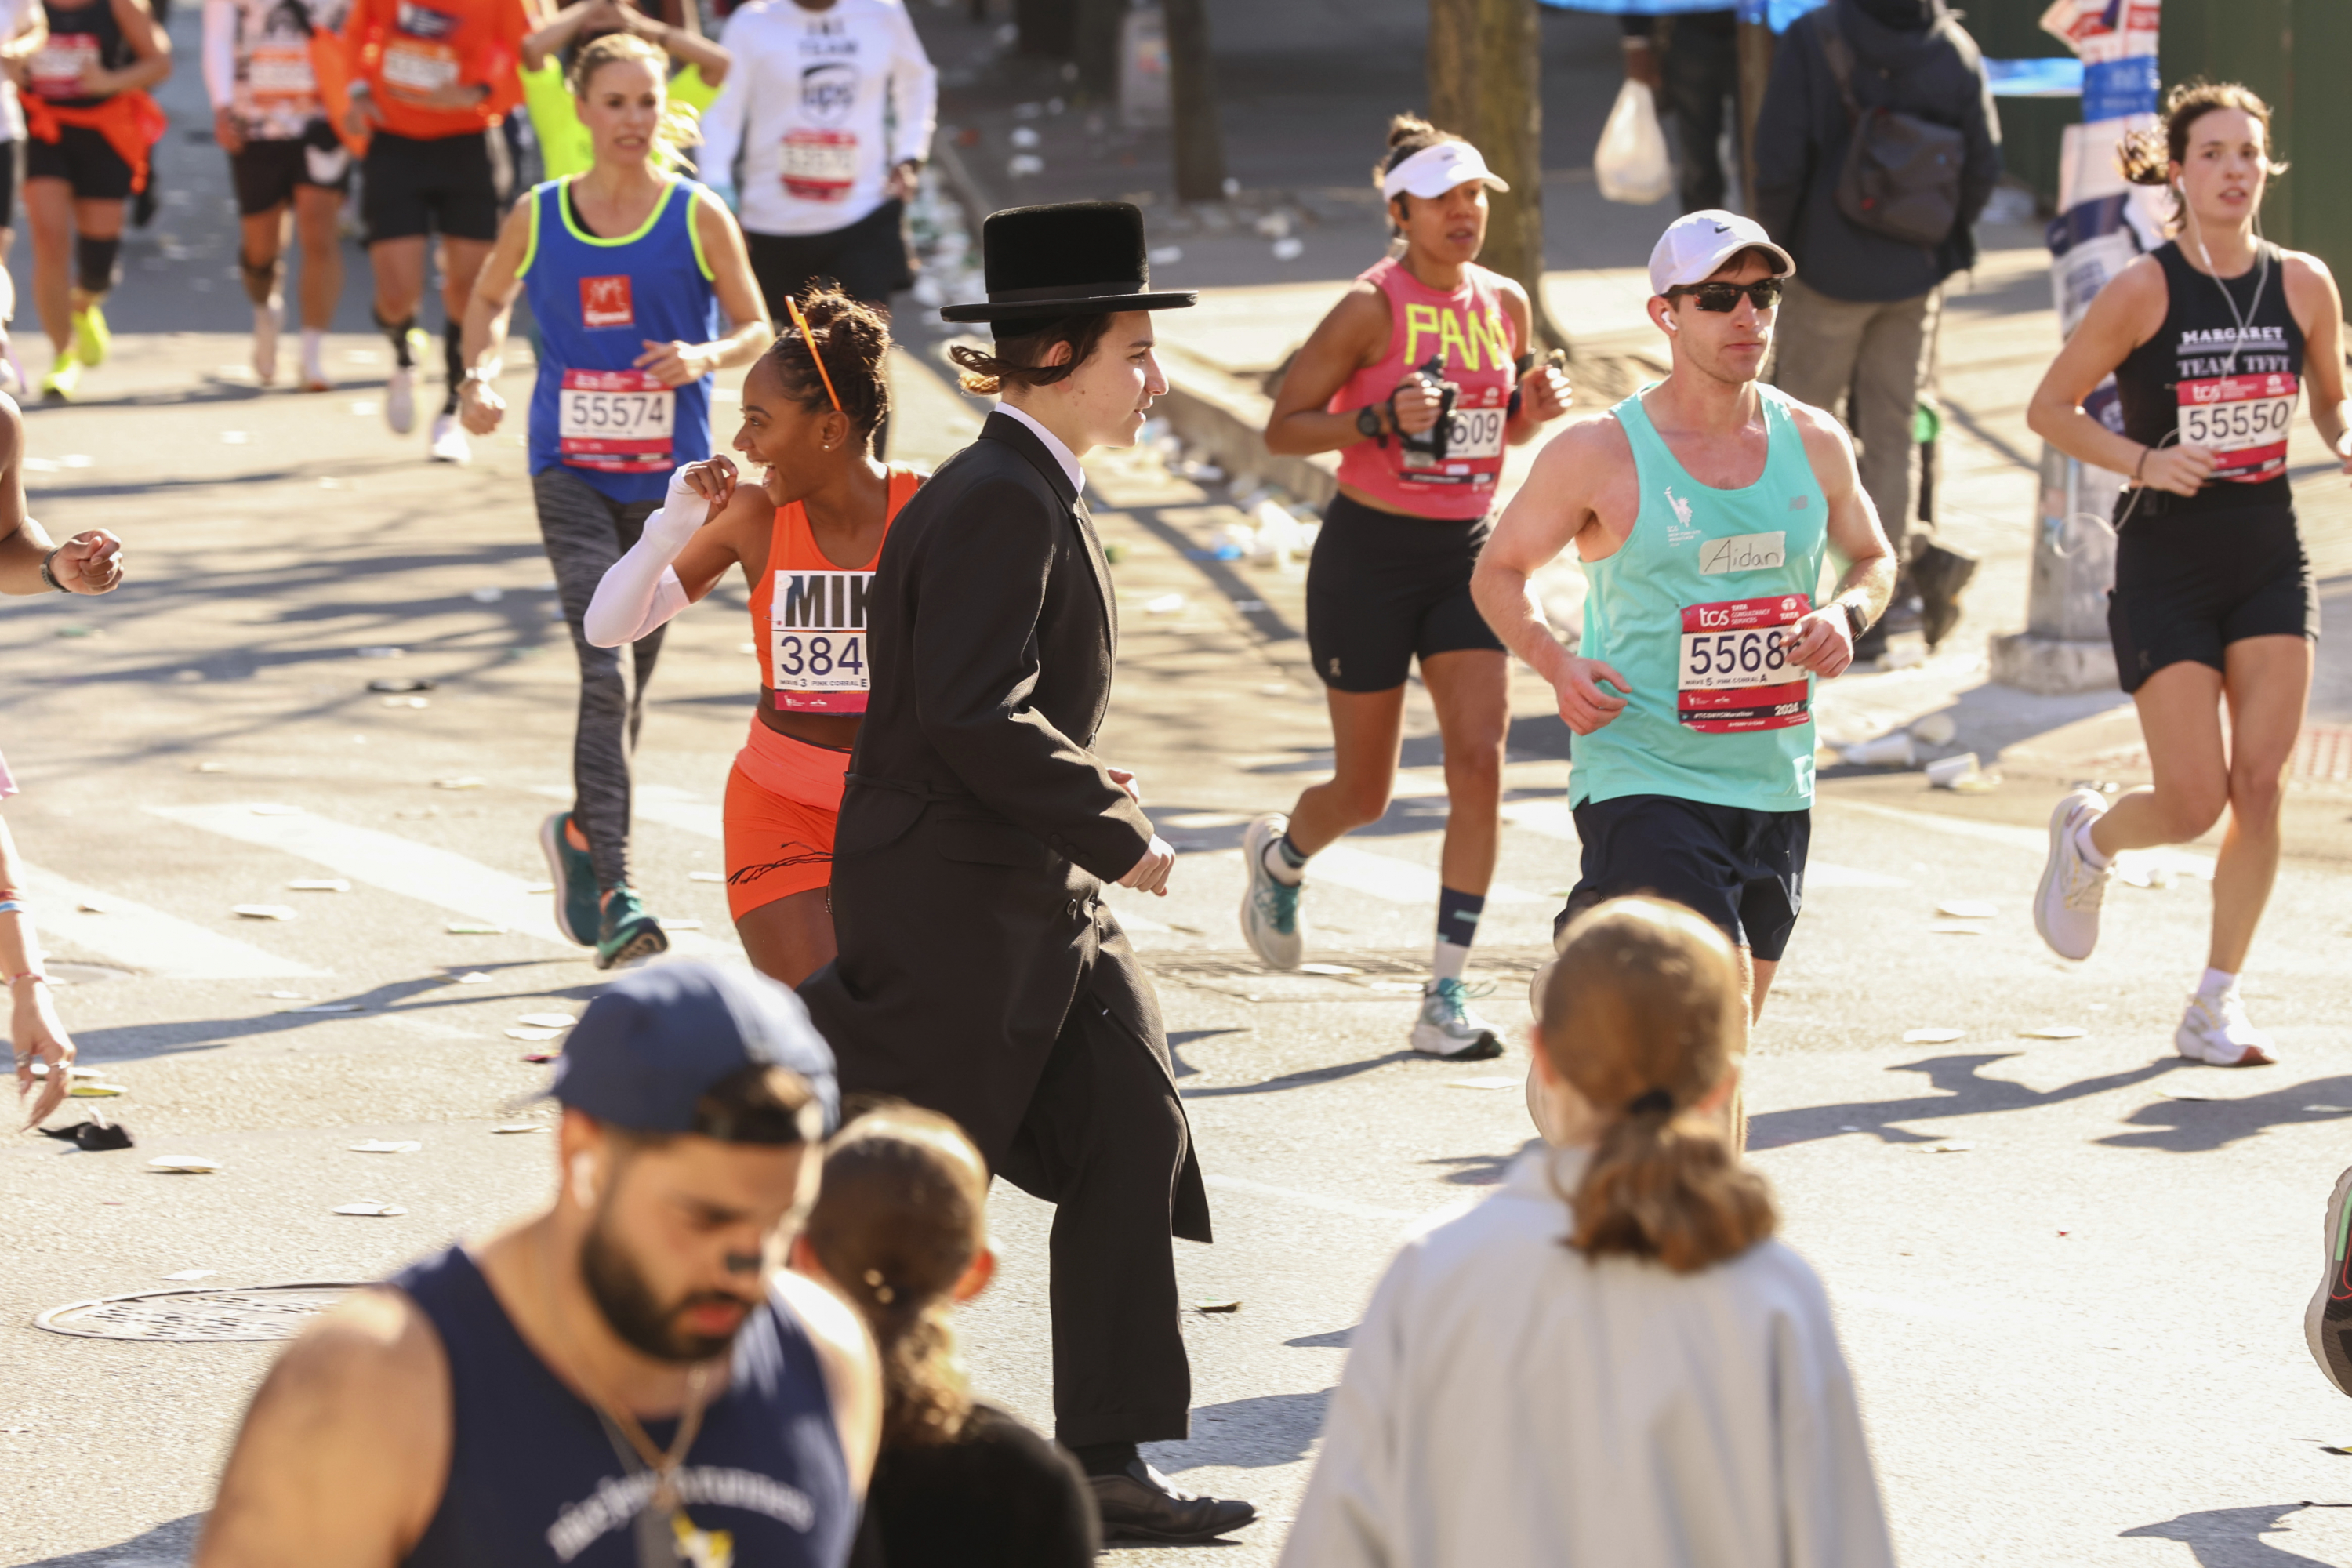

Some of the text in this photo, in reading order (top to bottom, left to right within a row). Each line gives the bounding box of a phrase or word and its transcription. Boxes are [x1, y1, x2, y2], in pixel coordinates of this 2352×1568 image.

[1404, 303, 1513, 372] PAM
[2182, 326, 2283, 345] MARGARET
[2177, 356, 2236, 378] TEAM
[572, 394, 664, 427] 55574
[2190, 400, 2289, 441] 55550
[1704, 539, 1780, 573] Aidan
[1700, 607, 1772, 627] tcs CONSULTANCY
[1731, 603, 1748, 612] TATA
[1780, 611, 1800, 620] TATA
[1730, 616, 1758, 626] SERVICES
[781, 636, 863, 676] 384
[800, 679, 808, 688] 3
[860, 679, 868, 688] E
[1705, 677, 1713, 686] 5
[1759, 673, 1768, 682] A
[1774, 702, 1799, 717] 2024
